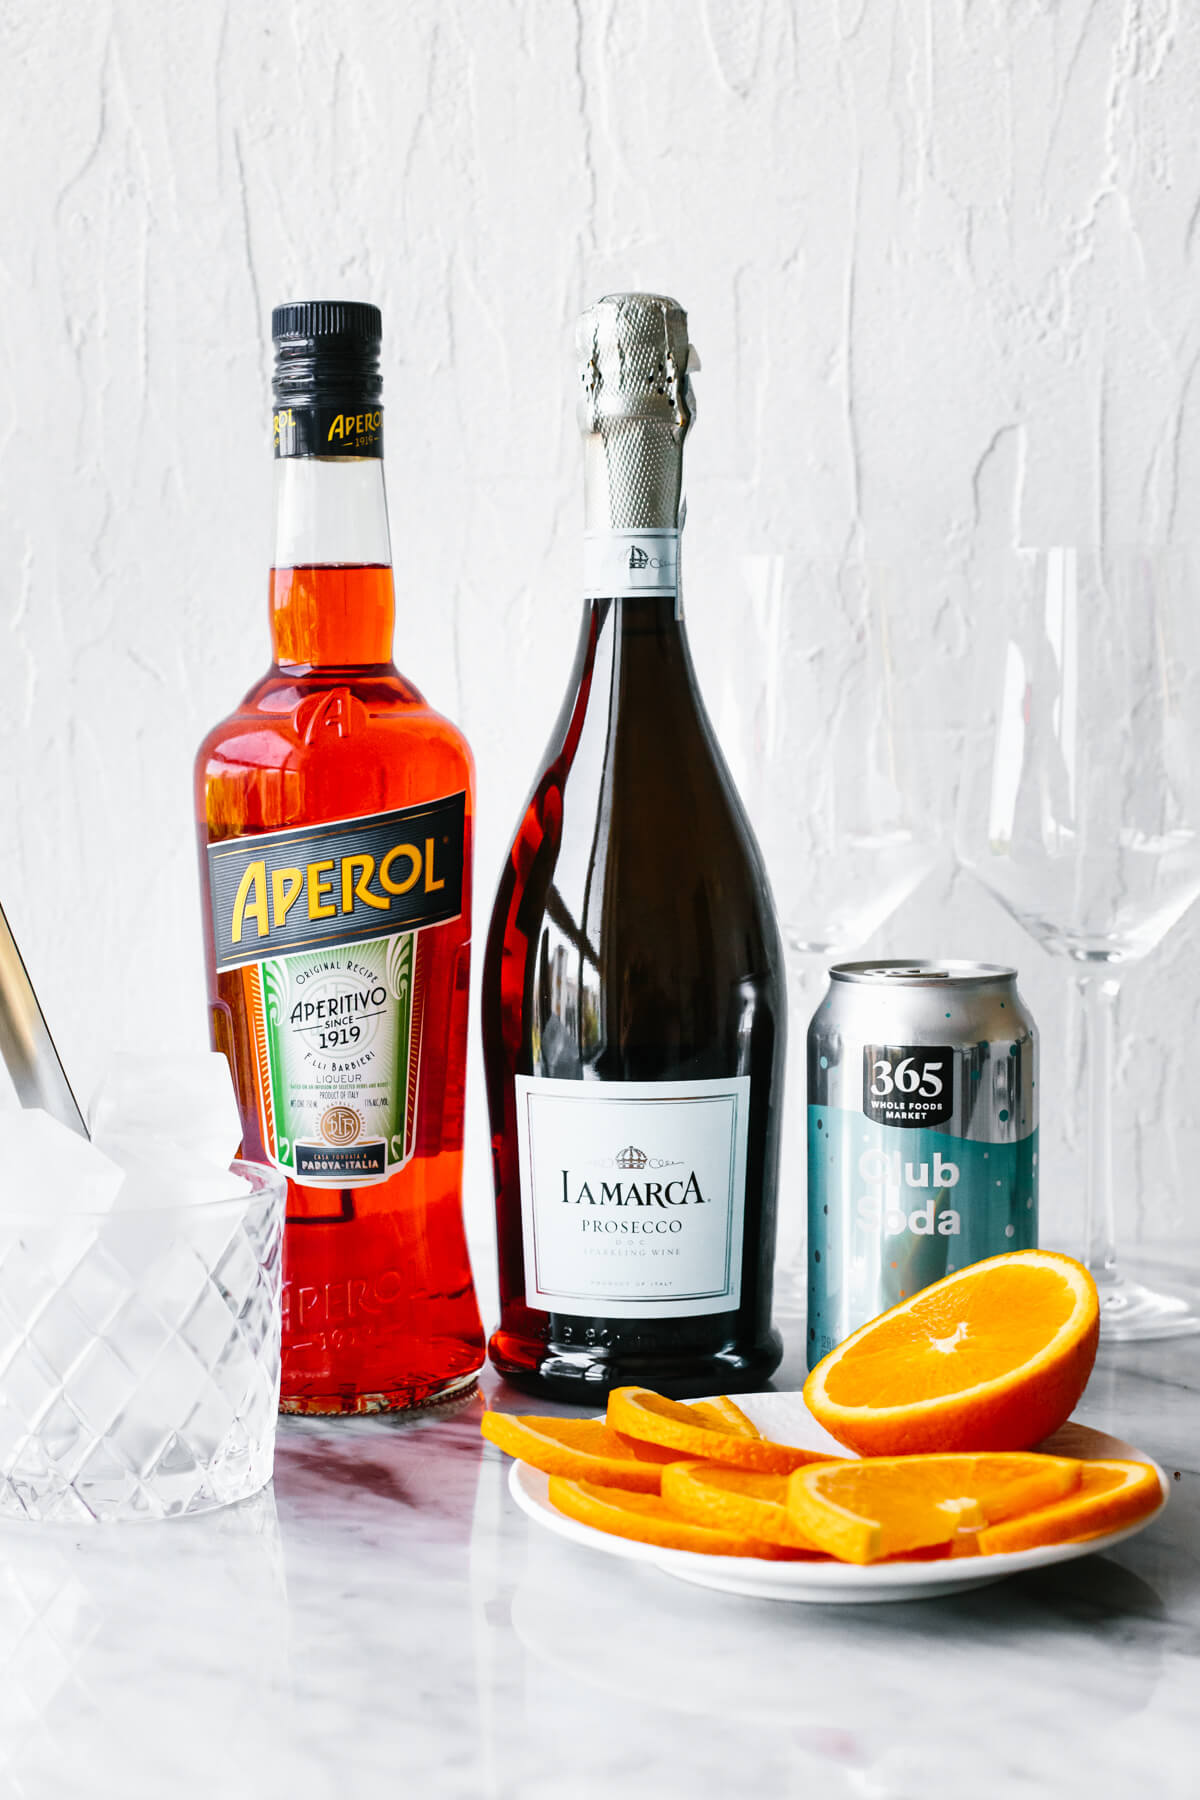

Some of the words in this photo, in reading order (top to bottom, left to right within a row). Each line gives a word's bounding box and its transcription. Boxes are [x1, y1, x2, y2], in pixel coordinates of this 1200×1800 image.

[231, 837, 446, 944] APEROL
[296, 960, 341, 985] ORIGINAL
[346, 960, 379, 984] RECIPE
[290, 986, 387, 1025] APERITIVO
[324, 1015, 355, 1029] SINCE
[319, 1026, 361, 1049] 1919
[331, 1050, 376, 1072] BARBIERI
[316, 1074, 362, 1083] LIQUEUR
[870, 1056, 943, 1097] 365
[871, 1101, 905, 1111] WHOLE
[908, 1102, 943, 1111] FOODS
[885, 1111, 928, 1121] MARKET
[858, 1148, 960, 1188] Club
[856, 1195, 961, 1236] Soda
[581, 1219, 683, 1235] PROSECCO
[651, 1248, 681, 1257] WINE
